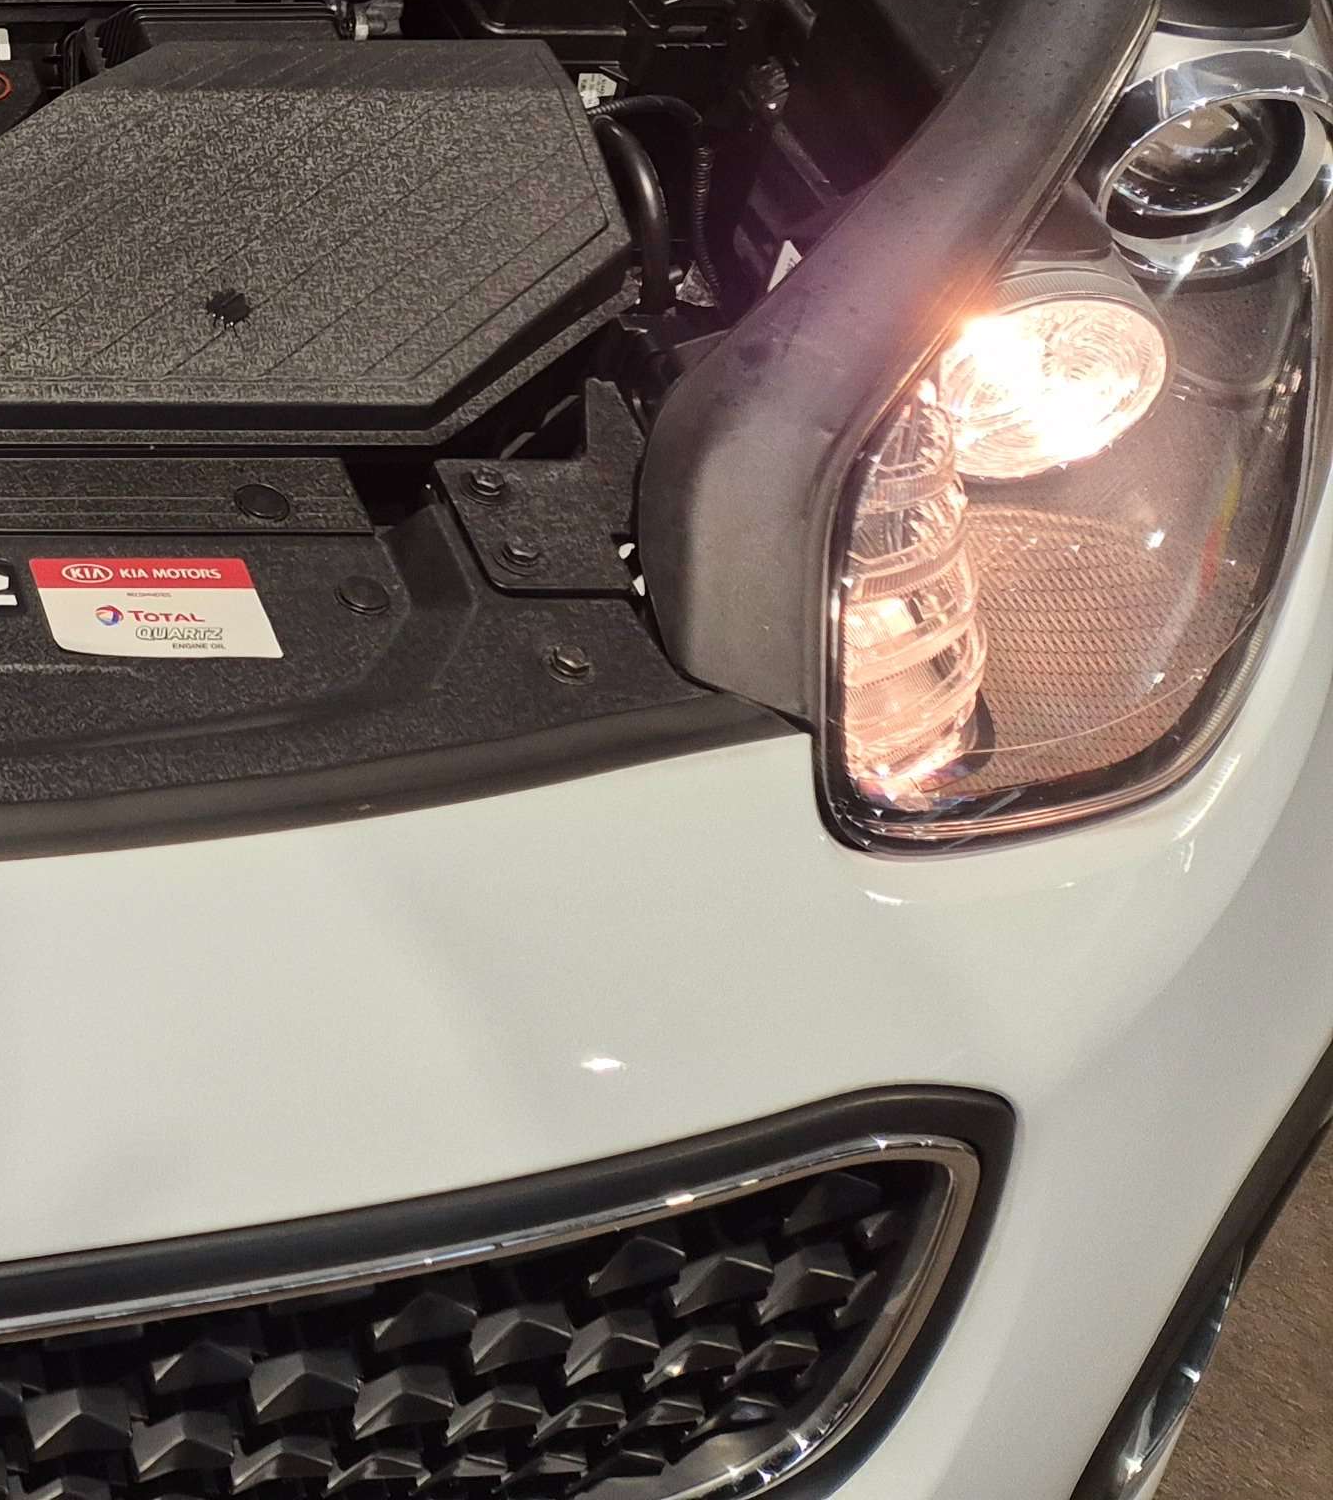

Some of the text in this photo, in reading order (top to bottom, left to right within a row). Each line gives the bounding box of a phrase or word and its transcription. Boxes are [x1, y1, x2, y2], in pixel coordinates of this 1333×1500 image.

[68, 567, 105, 580] KIA
[118, 568, 222, 580] KIA MOTORS
[127, 610, 206, 623] TOTAL
[135, 626, 224, 641] QUARTZ
